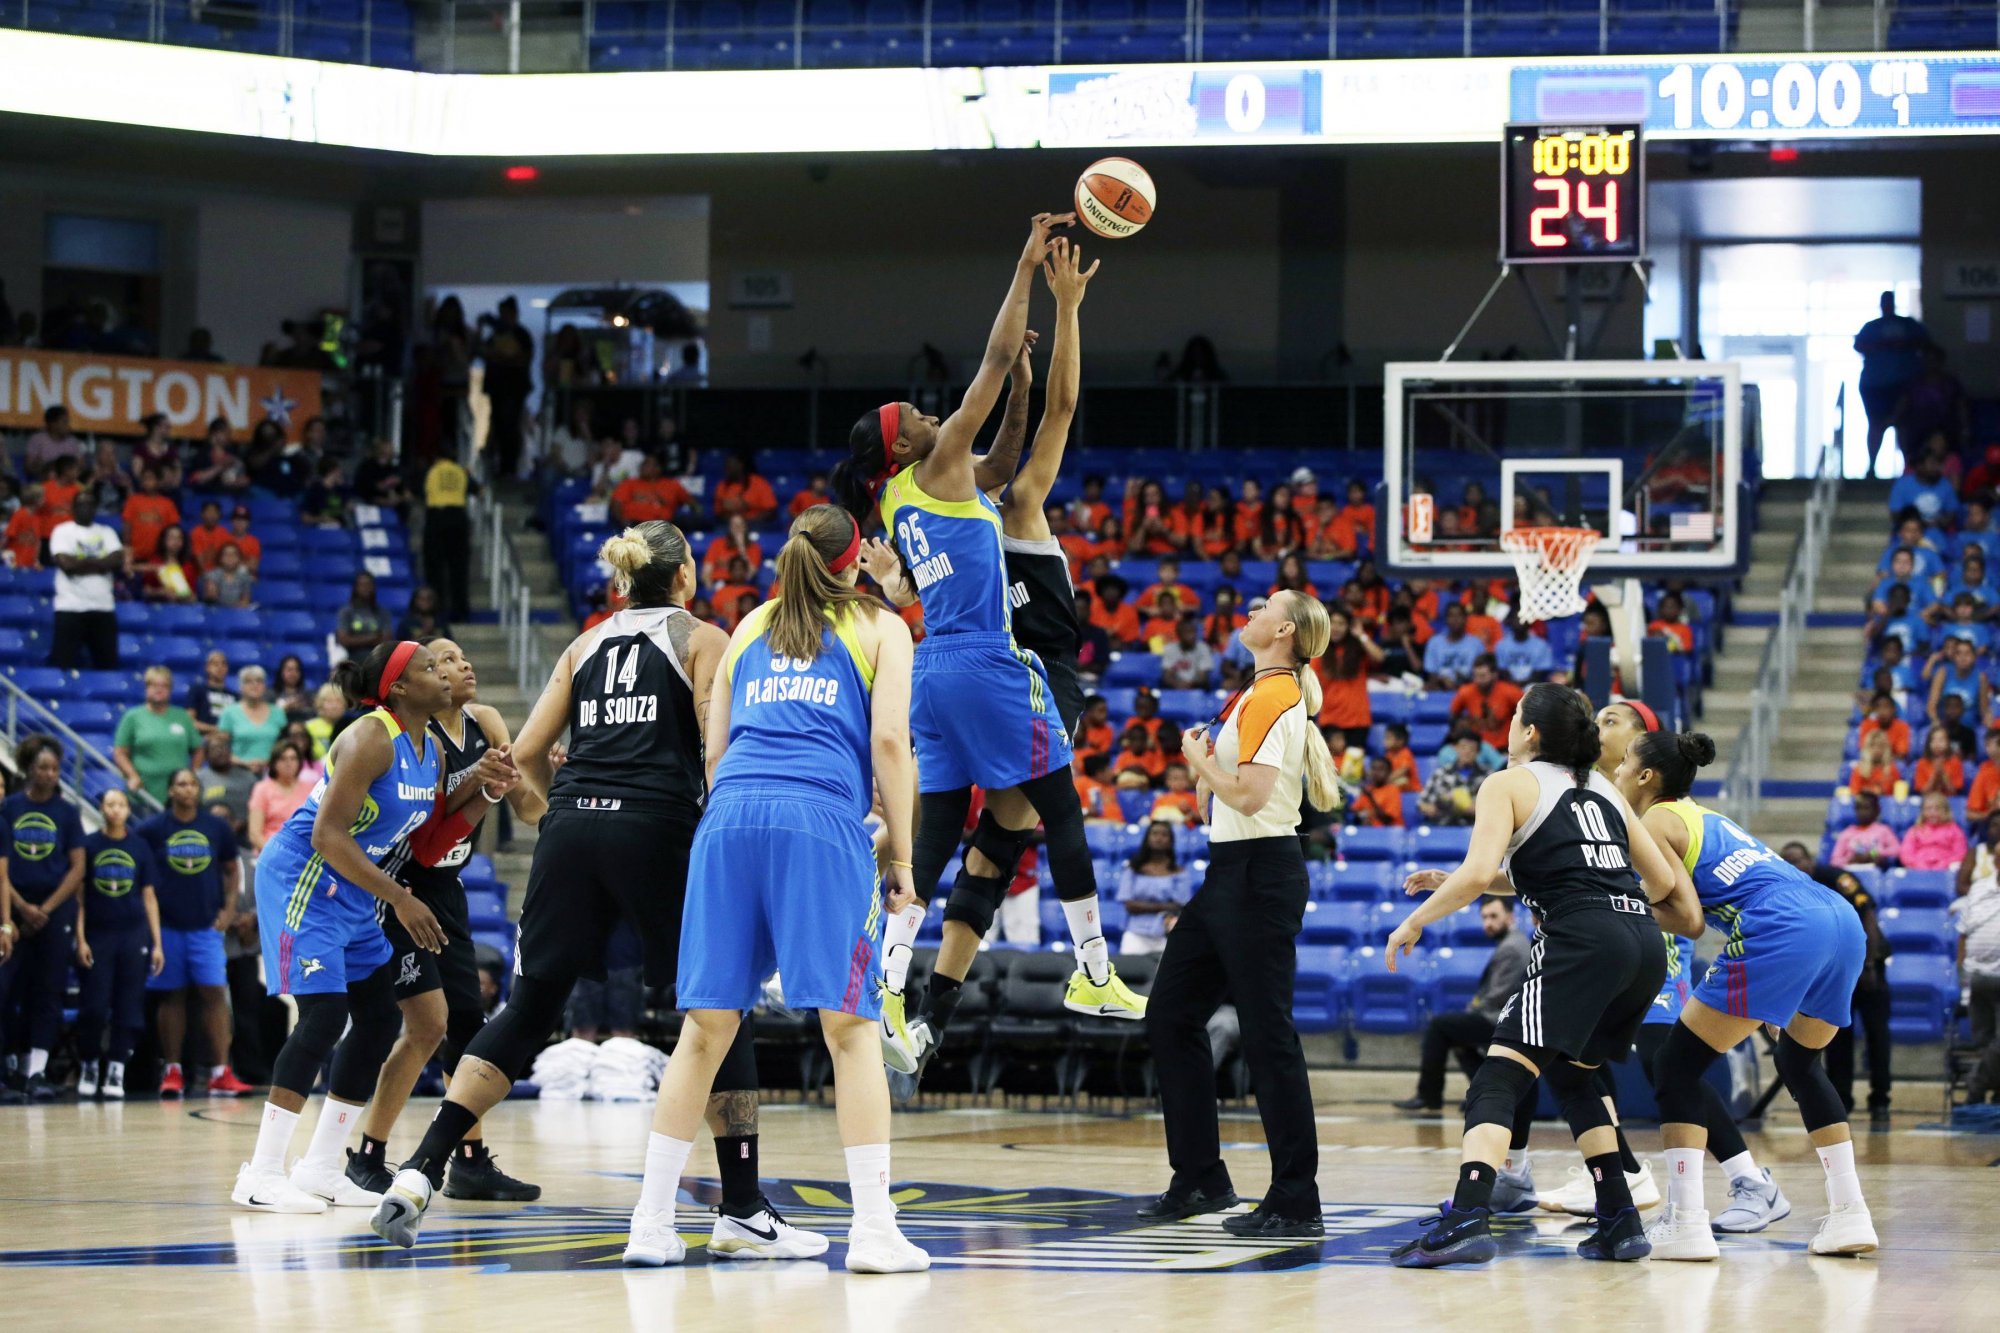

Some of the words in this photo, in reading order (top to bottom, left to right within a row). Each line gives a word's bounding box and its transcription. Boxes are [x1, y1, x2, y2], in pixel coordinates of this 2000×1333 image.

[1225, 74, 1266, 133] 0
[1658, 62, 1862, 129] 10:00
[1892, 93, 1910, 126] 1
[1533, 135, 1630, 176] 10:00
[1083, 197, 1134, 234] SPALDING
[1530, 178, 1618, 247] 24
[898, 511, 930, 566] 25
[604, 643, 640, 694] 14
[1570, 800, 1612, 842] 10
[1580, 844, 1628, 869] PLUM
